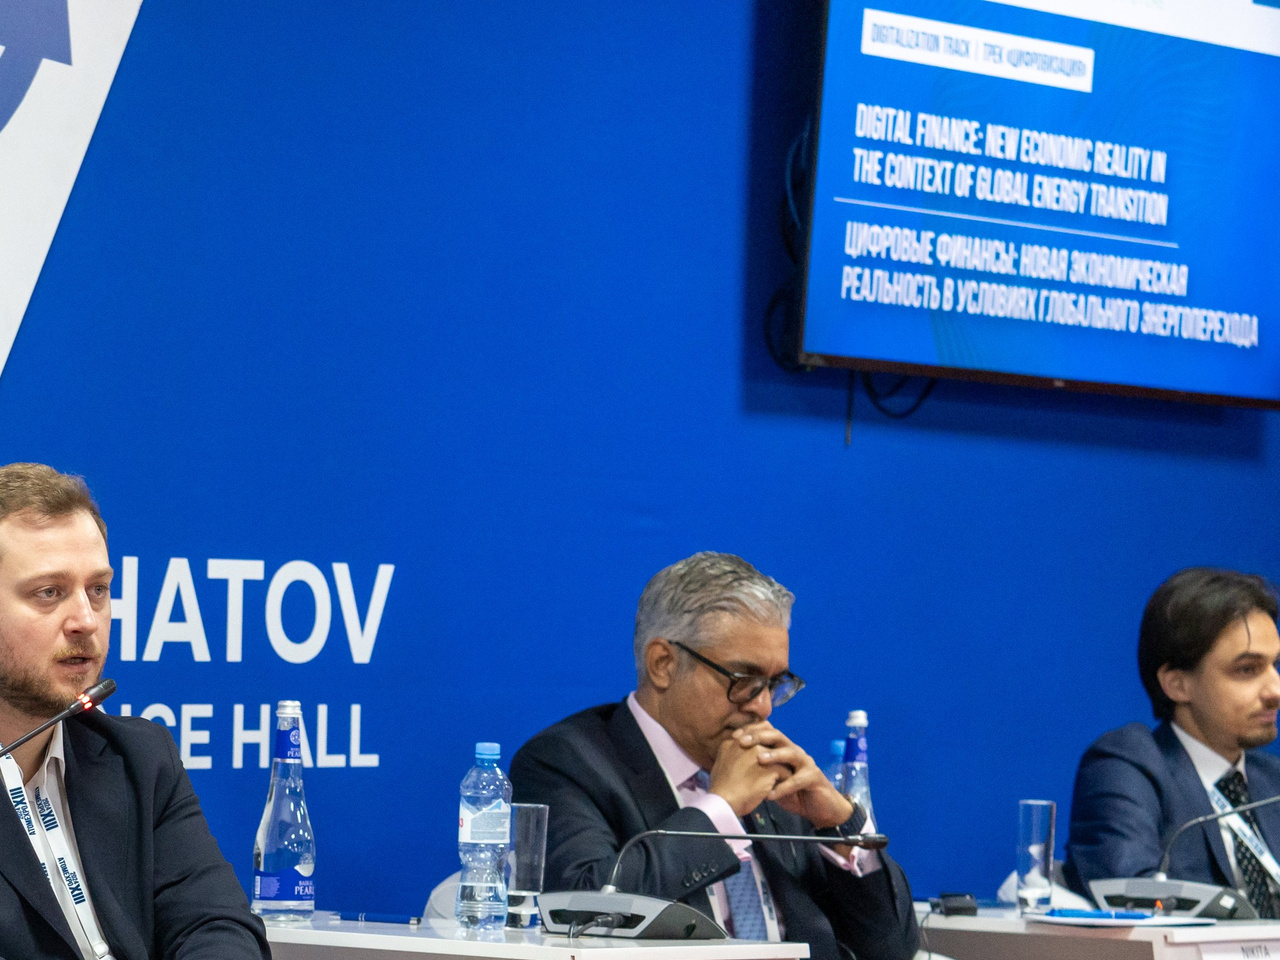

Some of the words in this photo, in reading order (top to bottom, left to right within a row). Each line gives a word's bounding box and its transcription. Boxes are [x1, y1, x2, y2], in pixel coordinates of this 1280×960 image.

[855, 102, 913, 145] DIGITAL
[916, 111, 984, 155] FINANCE:
[984, 123, 1020, 161] NEW
[1020, 128, 1093, 172] ECONOMIC
[1093, 140, 1151, 181] REALITY
[1150, 150, 1167, 184] IN
[853, 147, 884, 186] THE
[884, 152, 954, 195] CONTEXT
[954, 162, 976, 198] OF
[975, 165, 1031, 207] GLOBAL
[1032, 173, 1089, 214] ENERGY
[1090, 182, 1169, 226] TRANSITION
[844, 220, 935, 265] ЦИФРОВЫЕ
[936, 232, 1018, 276] ФИНАНСЫ:
[1019, 243, 1069, 282] НОВАЯ
[1070, 249, 1189, 297] ЭКОНОМИЧЕСКАЯ
[841, 265, 941, 310] РЕАЛЬНОСТЬ
[942, 276, 955, 312] В
[956, 278, 1038, 322] УСЛОВИЯХ
[1038, 288, 1140, 334] ГЛОБАЛЬНОГО
[1140, 301, 1259, 349] ЭНЕРГОПЕРЕХОДА
[9, 786, 27, 807] XIII
[20, 805, 36, 836] ATOMEXPO
[40, 809, 59, 831] XIII
[57, 857, 74, 887] ATOMEXPO
[70, 871, 79, 885] 2024
[69, 883, 86, 905] XIII
